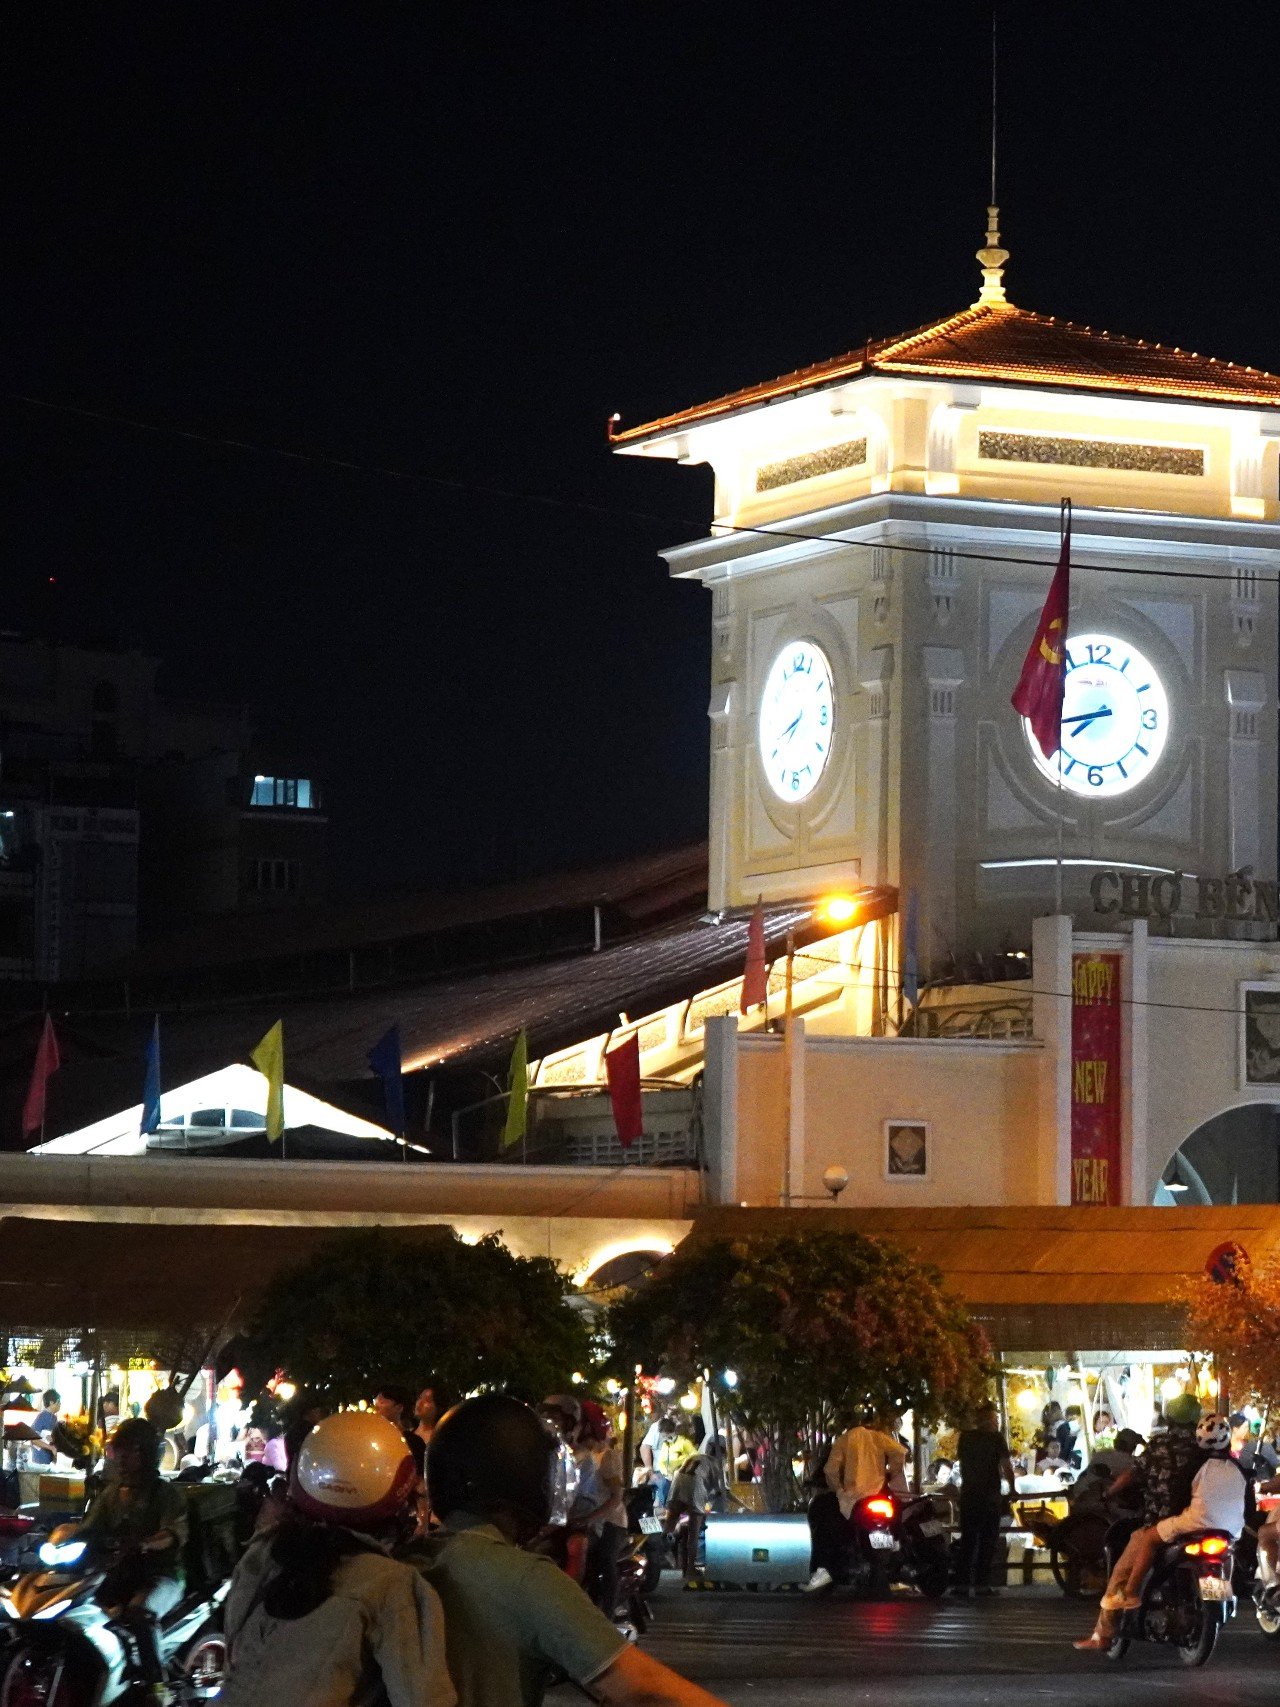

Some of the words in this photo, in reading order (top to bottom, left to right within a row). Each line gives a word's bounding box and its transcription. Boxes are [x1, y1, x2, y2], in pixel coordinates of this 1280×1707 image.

[1085, 644, 1112, 665] 12
[819, 704, 828, 726] 3
[1142, 708, 1158, 730] 3
[791, 771, 800, 791] 6
[1087, 765, 1104, 787] 6
[1075, 1060, 1109, 1104] NEW
[1073, 1158, 1110, 1207] YEAR
